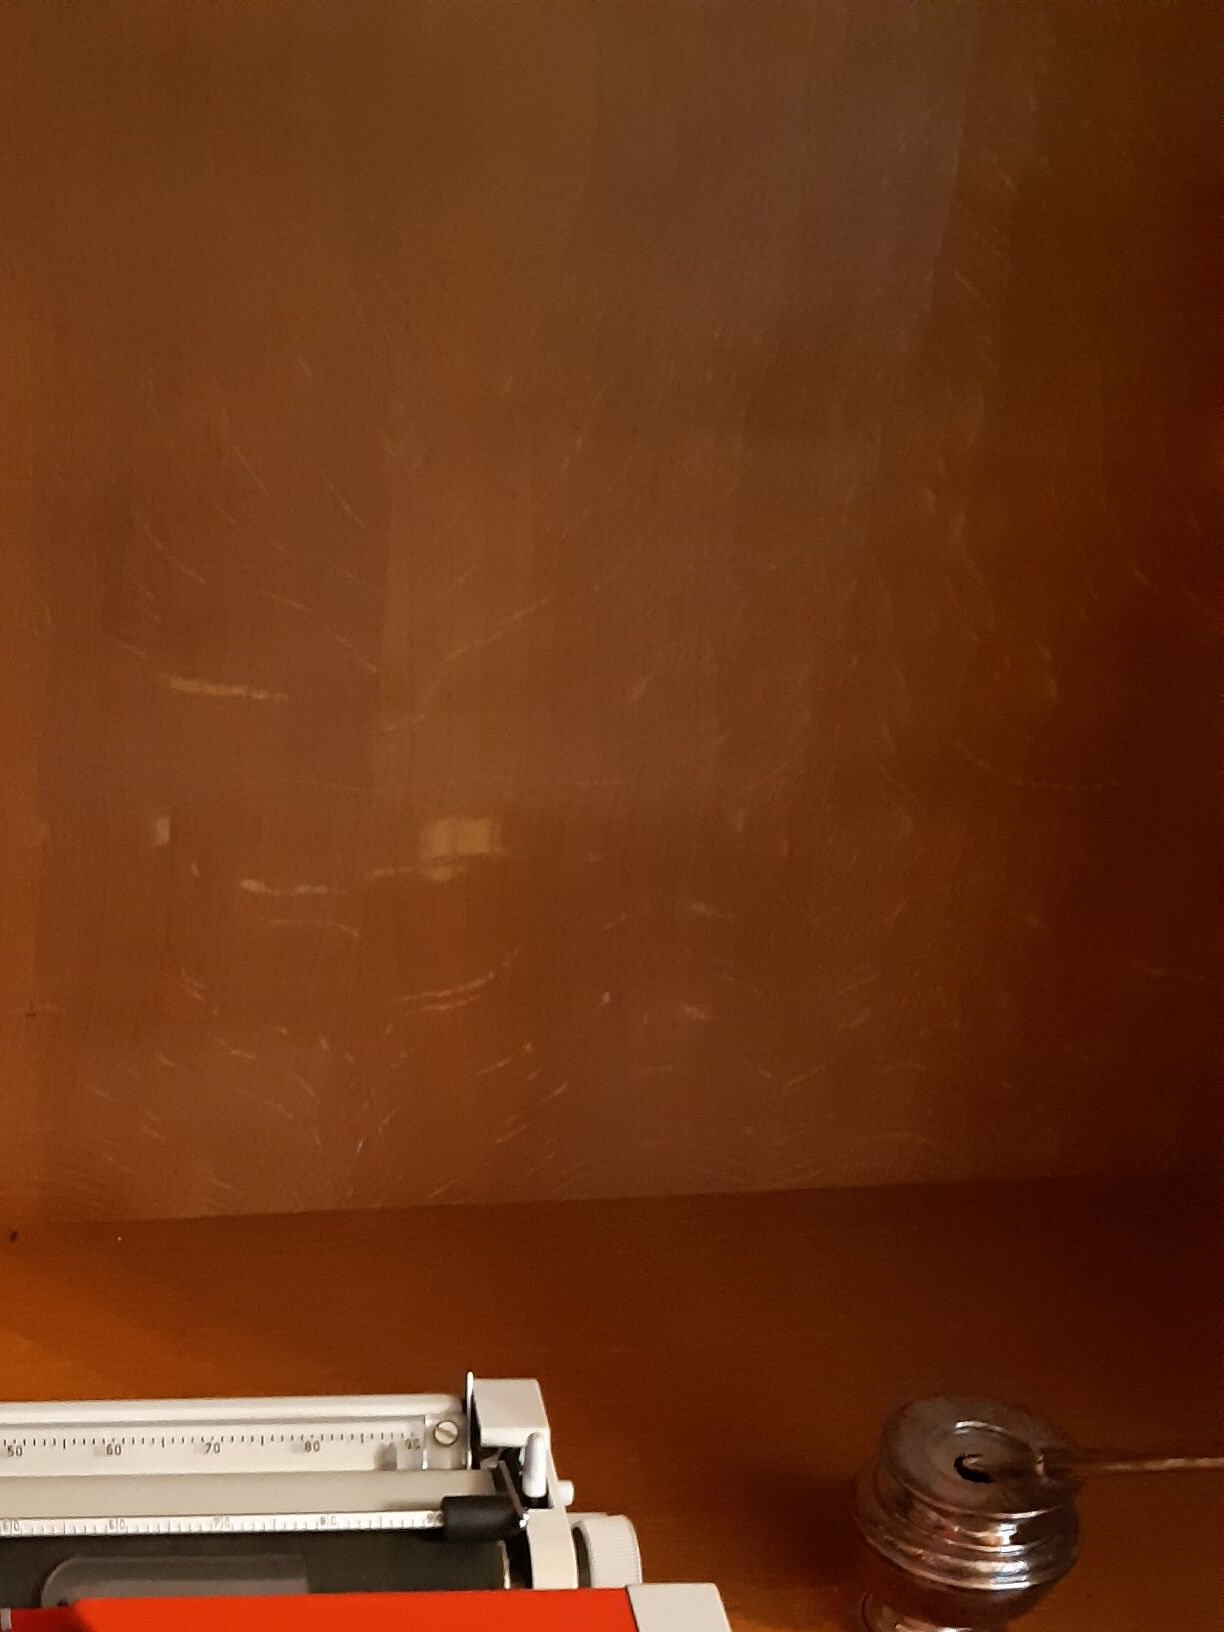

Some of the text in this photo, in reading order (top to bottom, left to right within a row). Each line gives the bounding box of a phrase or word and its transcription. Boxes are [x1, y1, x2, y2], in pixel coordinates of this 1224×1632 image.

[7, 1445, 23, 1457] 50
[106, 1444, 122, 1456] 60
[204, 1443, 221, 1454] 70
